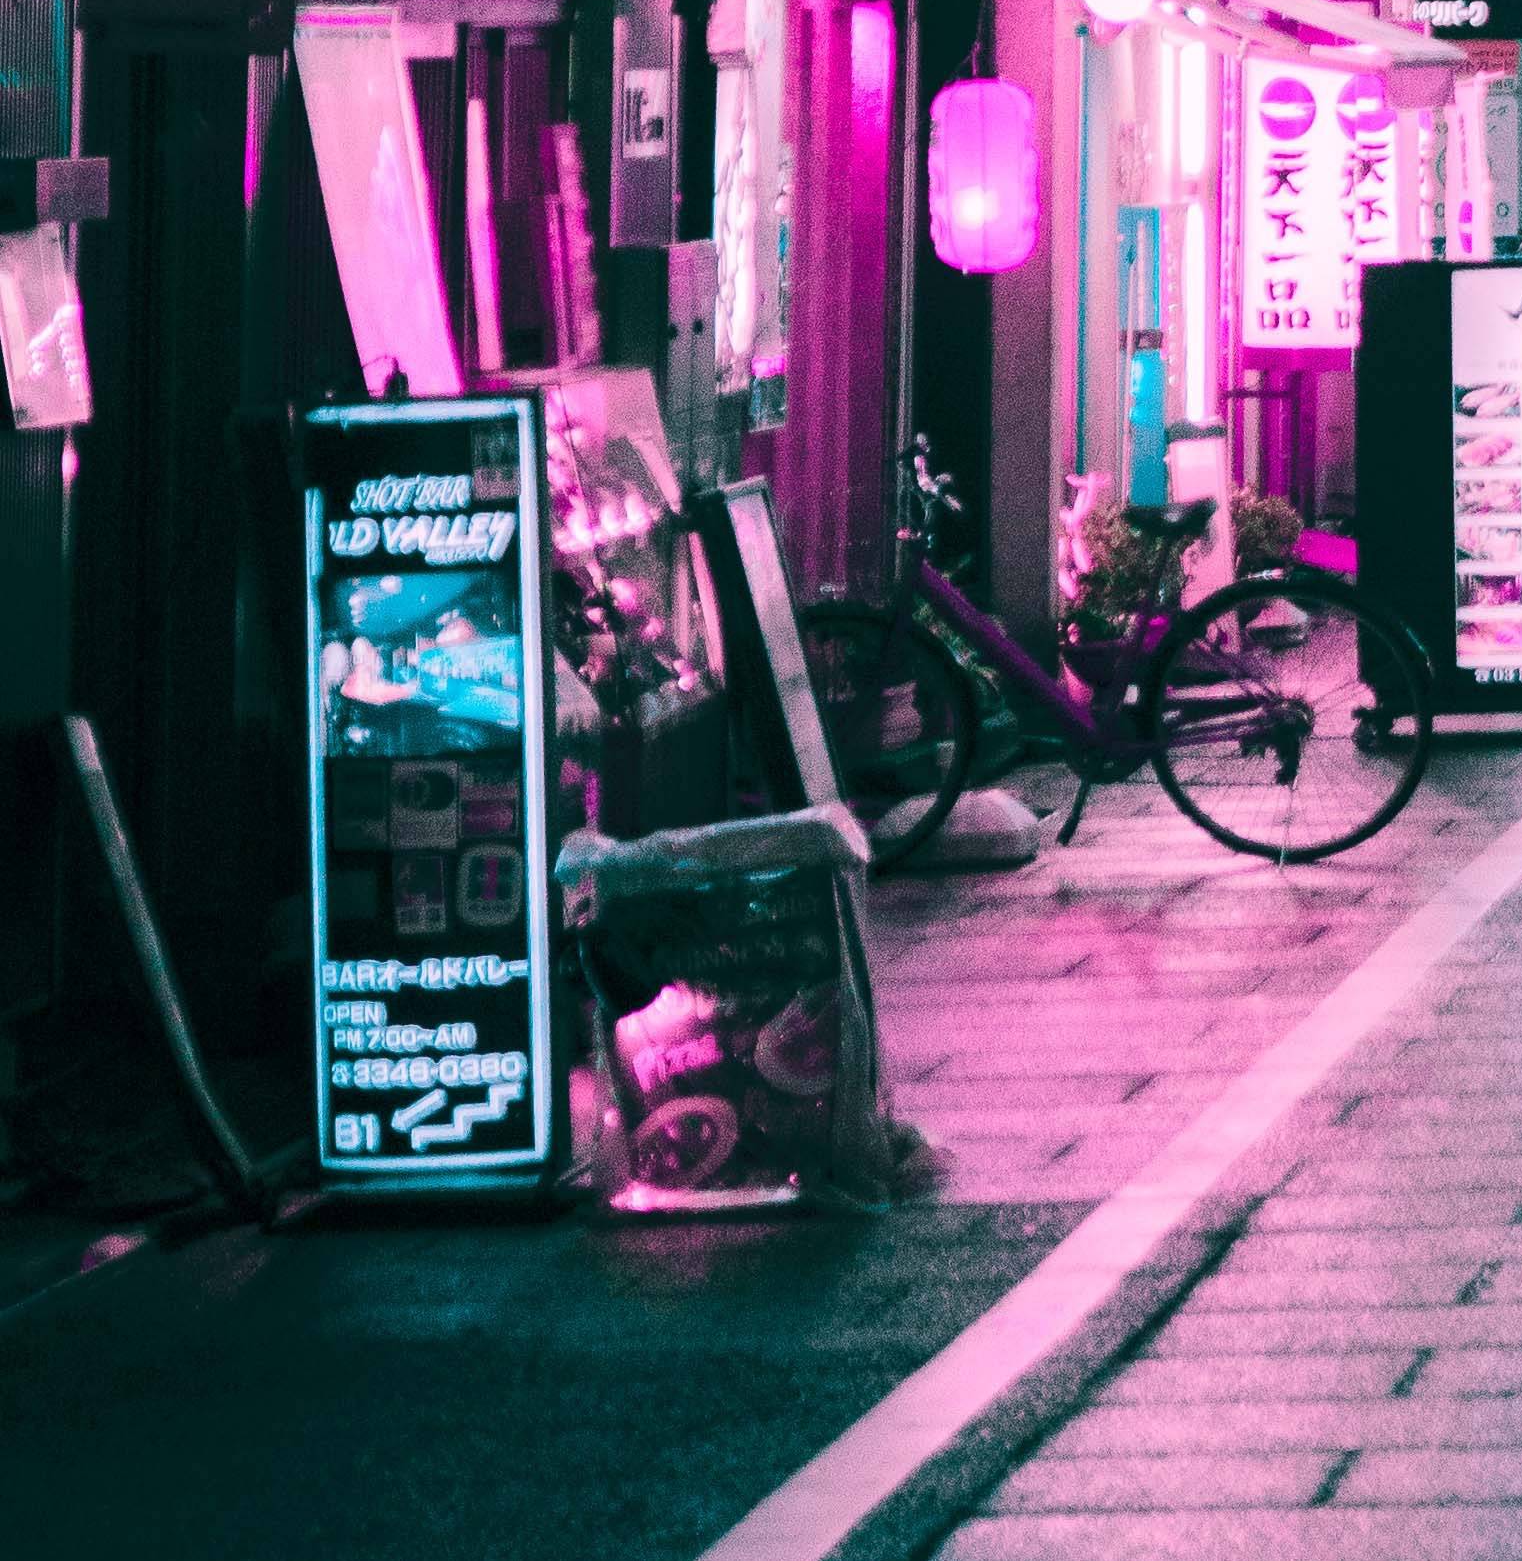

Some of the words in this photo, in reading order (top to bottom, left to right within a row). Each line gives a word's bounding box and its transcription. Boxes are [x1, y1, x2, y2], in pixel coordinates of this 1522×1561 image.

[351, 474, 415, 514] SHOT
[414, 473, 472, 511] BAR
[383, 510, 517, 562] VALLEY
[323, 1001, 388, 1025] OPEN
[333, 1025, 363, 1052] PM
[334, 1113, 380, 1153] B1
